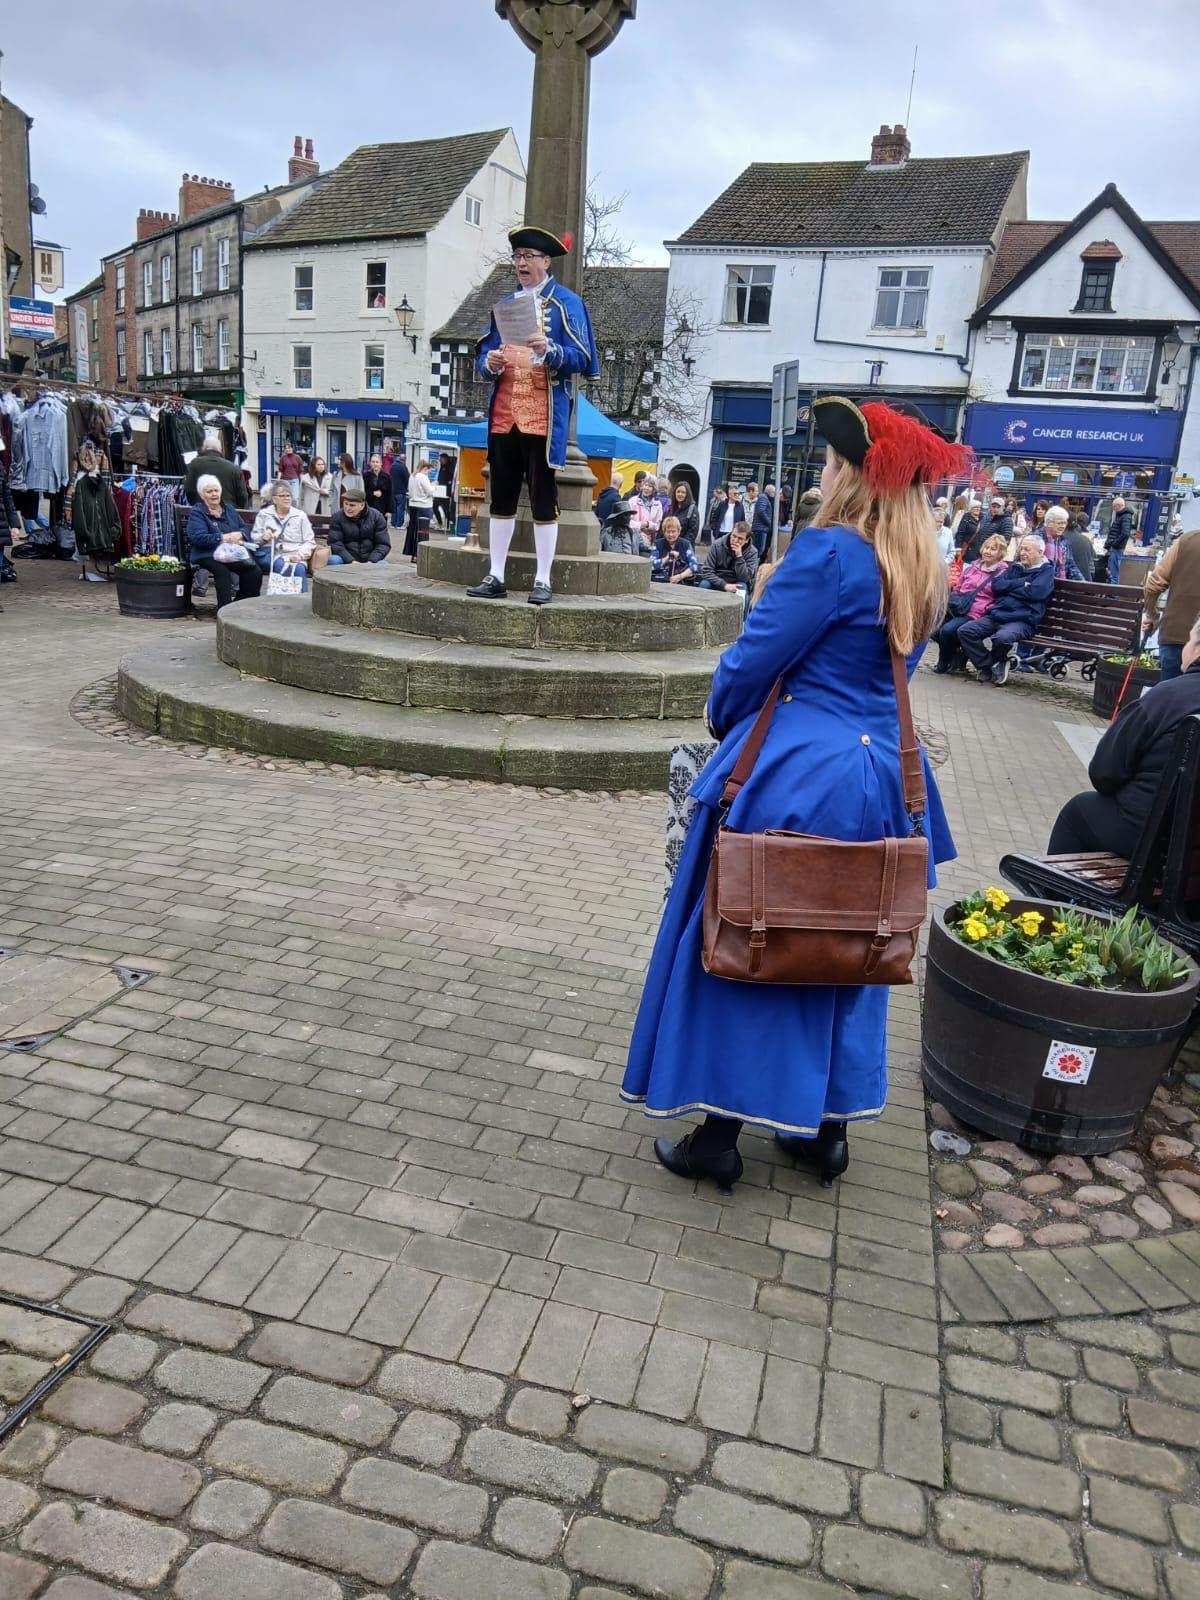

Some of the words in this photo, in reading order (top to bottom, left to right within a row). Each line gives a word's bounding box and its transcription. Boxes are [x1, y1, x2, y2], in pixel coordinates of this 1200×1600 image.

[40, 252, 53, 275] H
[10, 313, 33, 323] UNDER
[33, 315, 54, 325] OFFER
[428, 427, 456, 436] Yorkshire
[1032, 428, 1073, 439] CANCER
[1076, 430, 1127, 441] RESEARCH
[1130, 432, 1144, 442] UK
